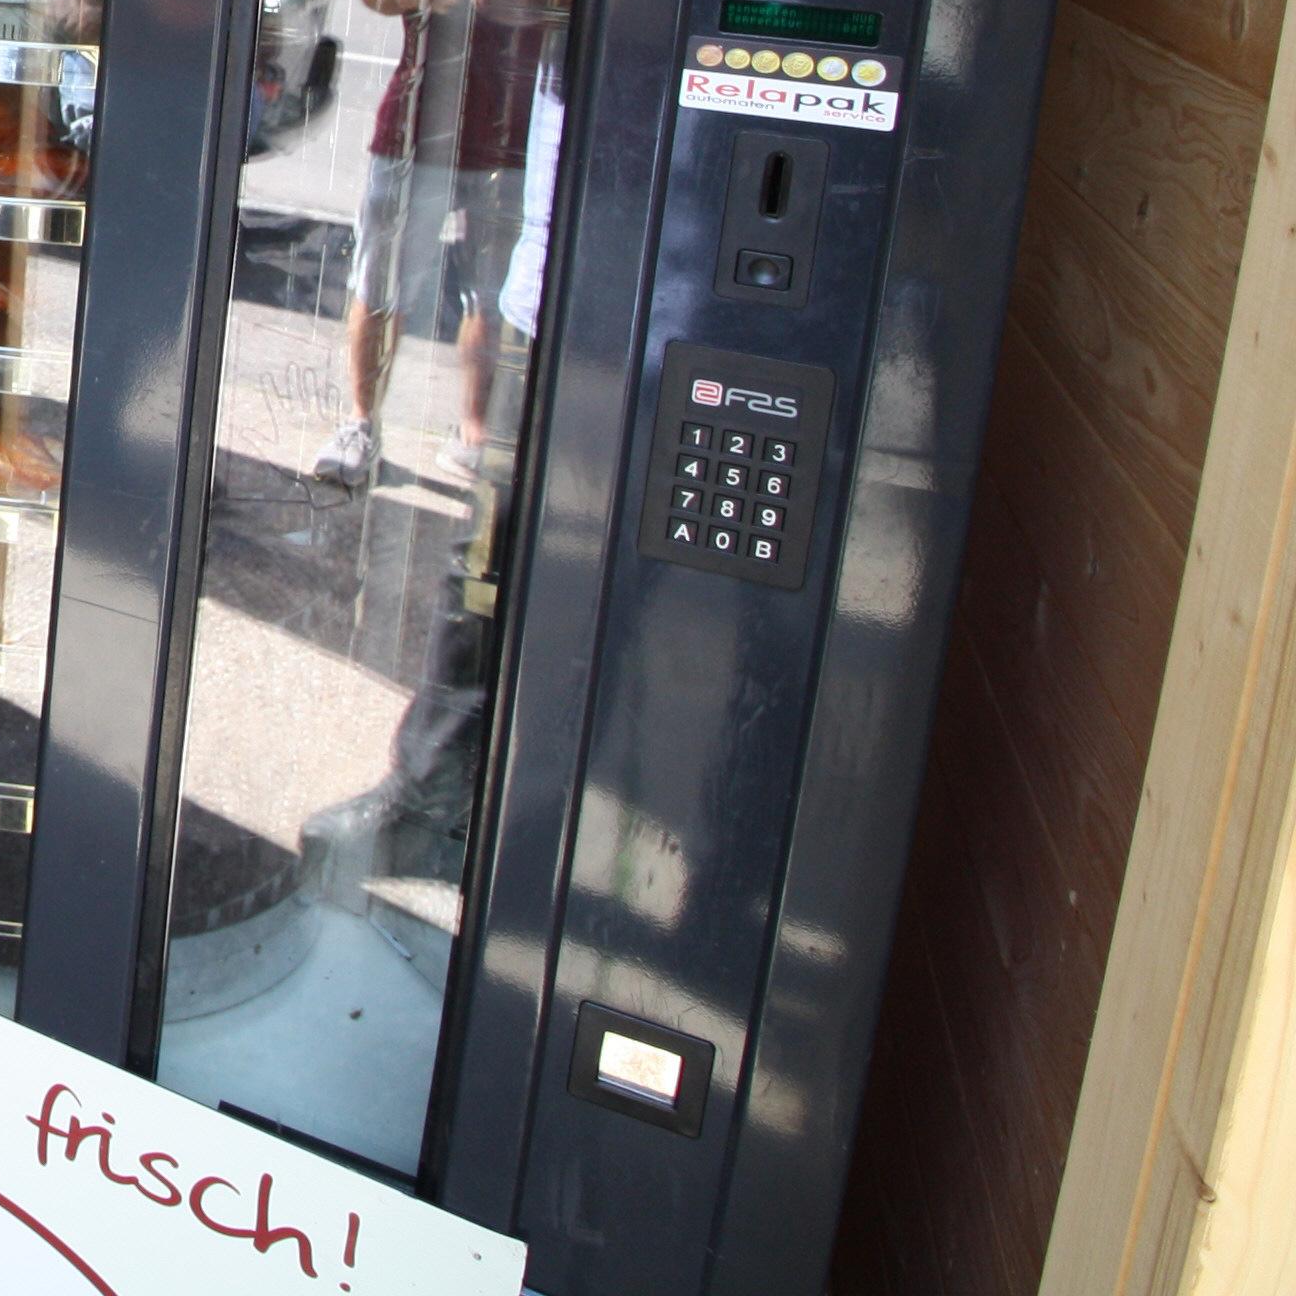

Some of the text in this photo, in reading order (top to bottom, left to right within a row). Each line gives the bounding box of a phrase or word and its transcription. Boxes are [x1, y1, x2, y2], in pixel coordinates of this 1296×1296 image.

[685, 92, 775, 110] automaten
[823, 109, 886, 123] service
[692, 428, 786, 462] 1 2 3
[684, 460, 781, 494] 4 5 6
[681, 491, 776, 527] 7 8 9
[673, 524, 690, 542] A
[755, 540, 772, 559] B
[24, 1083, 360, 1295] frisch!
